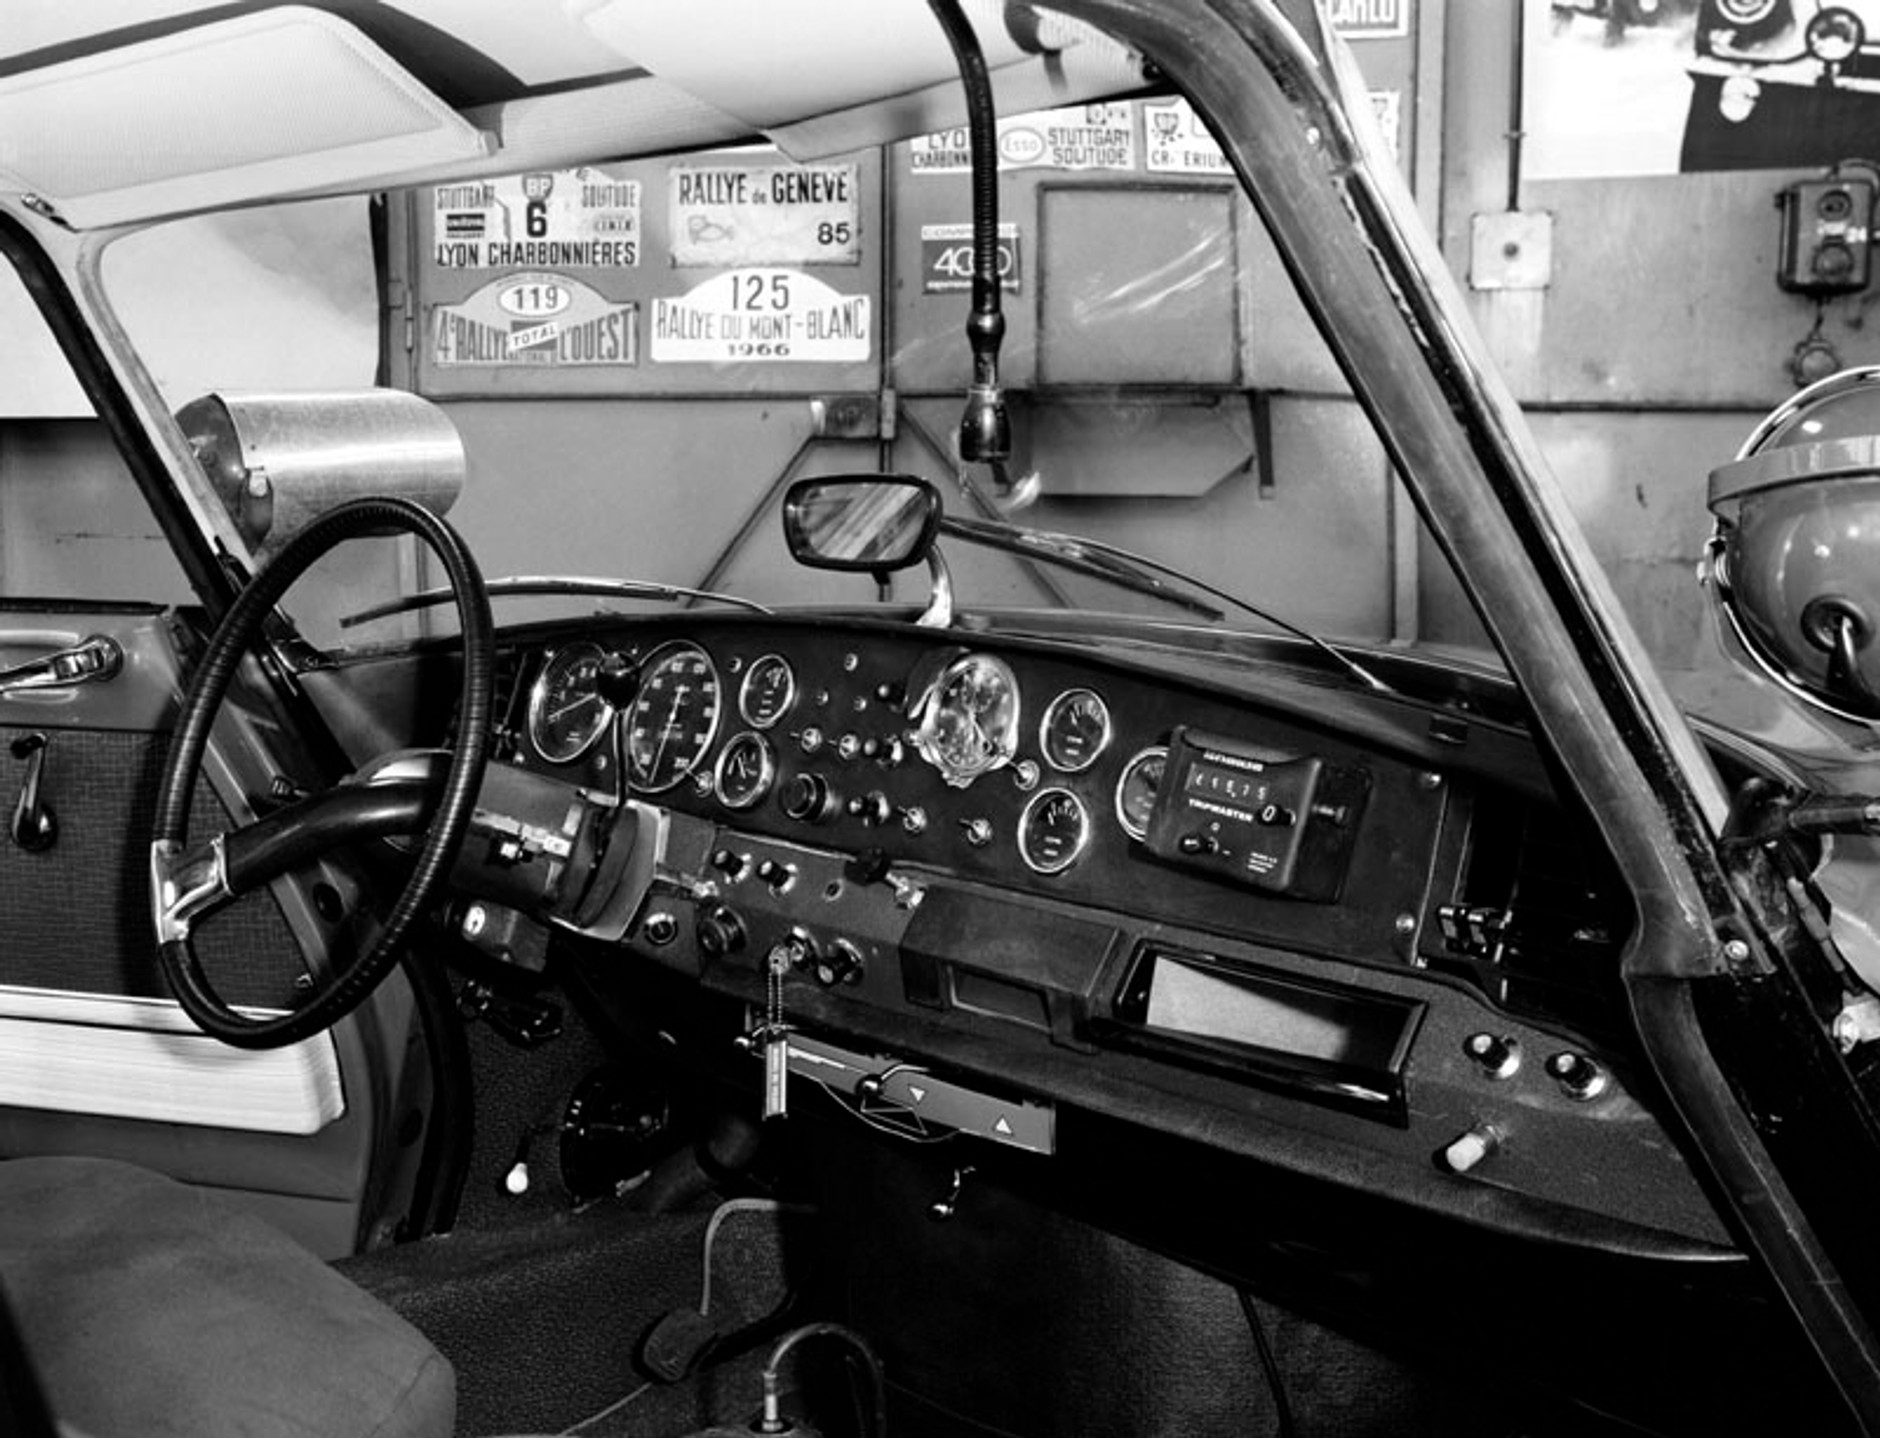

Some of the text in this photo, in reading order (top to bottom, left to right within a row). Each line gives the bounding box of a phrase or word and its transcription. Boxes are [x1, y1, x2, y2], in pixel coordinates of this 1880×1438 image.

[679, 172, 747, 205] RALLYE
[526, 200, 547, 238] 6
[817, 221, 850, 245] 85
[437, 242, 478, 268] LYON
[513, 285, 559, 311] 119
[732, 274, 790, 311] 125
[657, 300, 714, 340] RALLYE
[721, 314, 741, 340] DU
[456, 316, 509, 361] RALLYE
[513, 325, 556, 348] TOTAL
[728, 343, 791, 357] 1966
